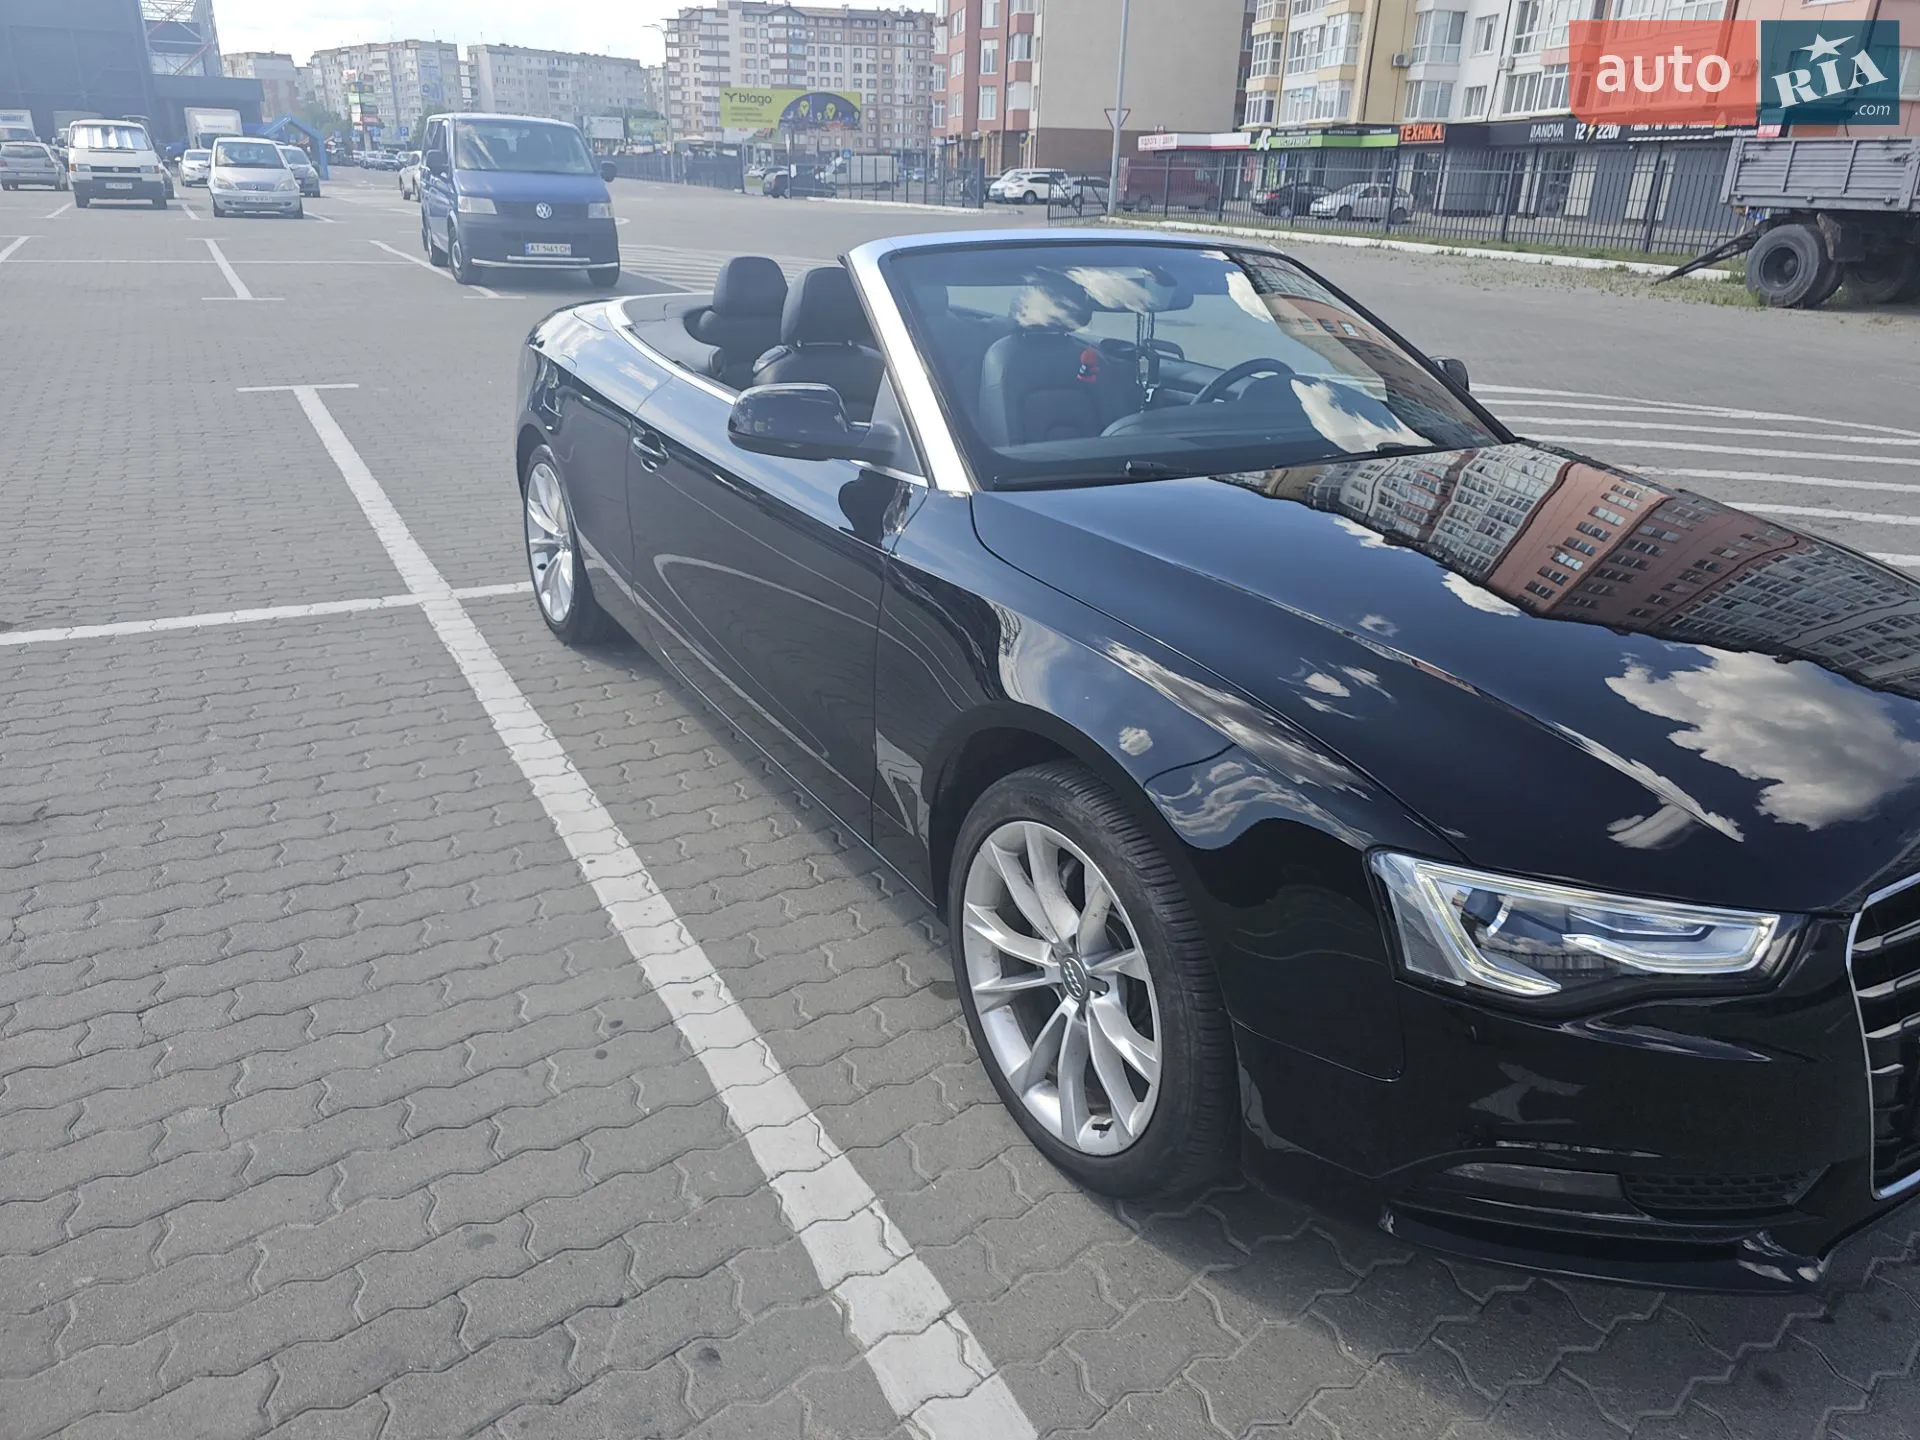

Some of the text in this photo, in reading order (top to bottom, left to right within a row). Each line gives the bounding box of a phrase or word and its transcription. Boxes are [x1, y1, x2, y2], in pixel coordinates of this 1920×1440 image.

[739, 92, 772, 106] blago
[1400, 123, 1442, 140] ТЕХНІКА
[1574, 123, 1587, 140] 12
